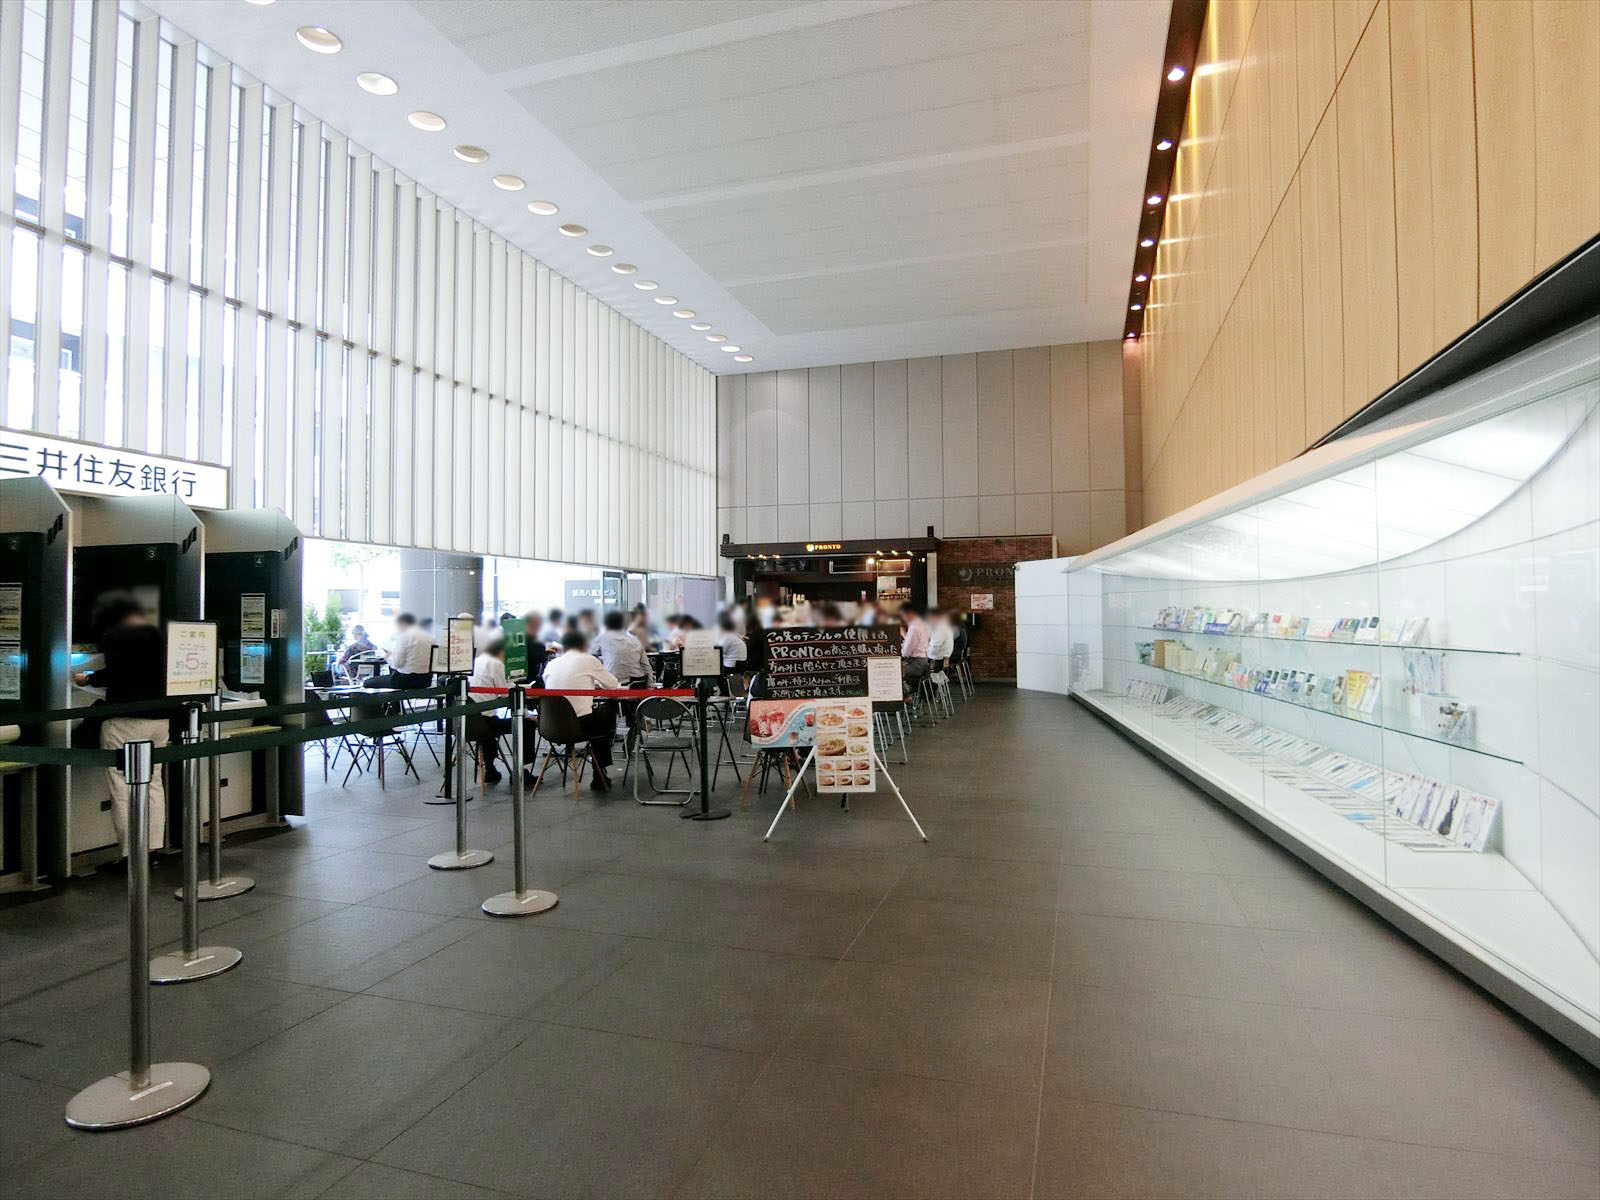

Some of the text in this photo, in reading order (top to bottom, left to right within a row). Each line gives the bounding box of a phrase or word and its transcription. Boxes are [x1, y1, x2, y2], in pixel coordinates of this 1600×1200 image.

[0, 443, 197, 497] 三井住友銀行
[572, 588, 616, 597] 読売八重ビル
